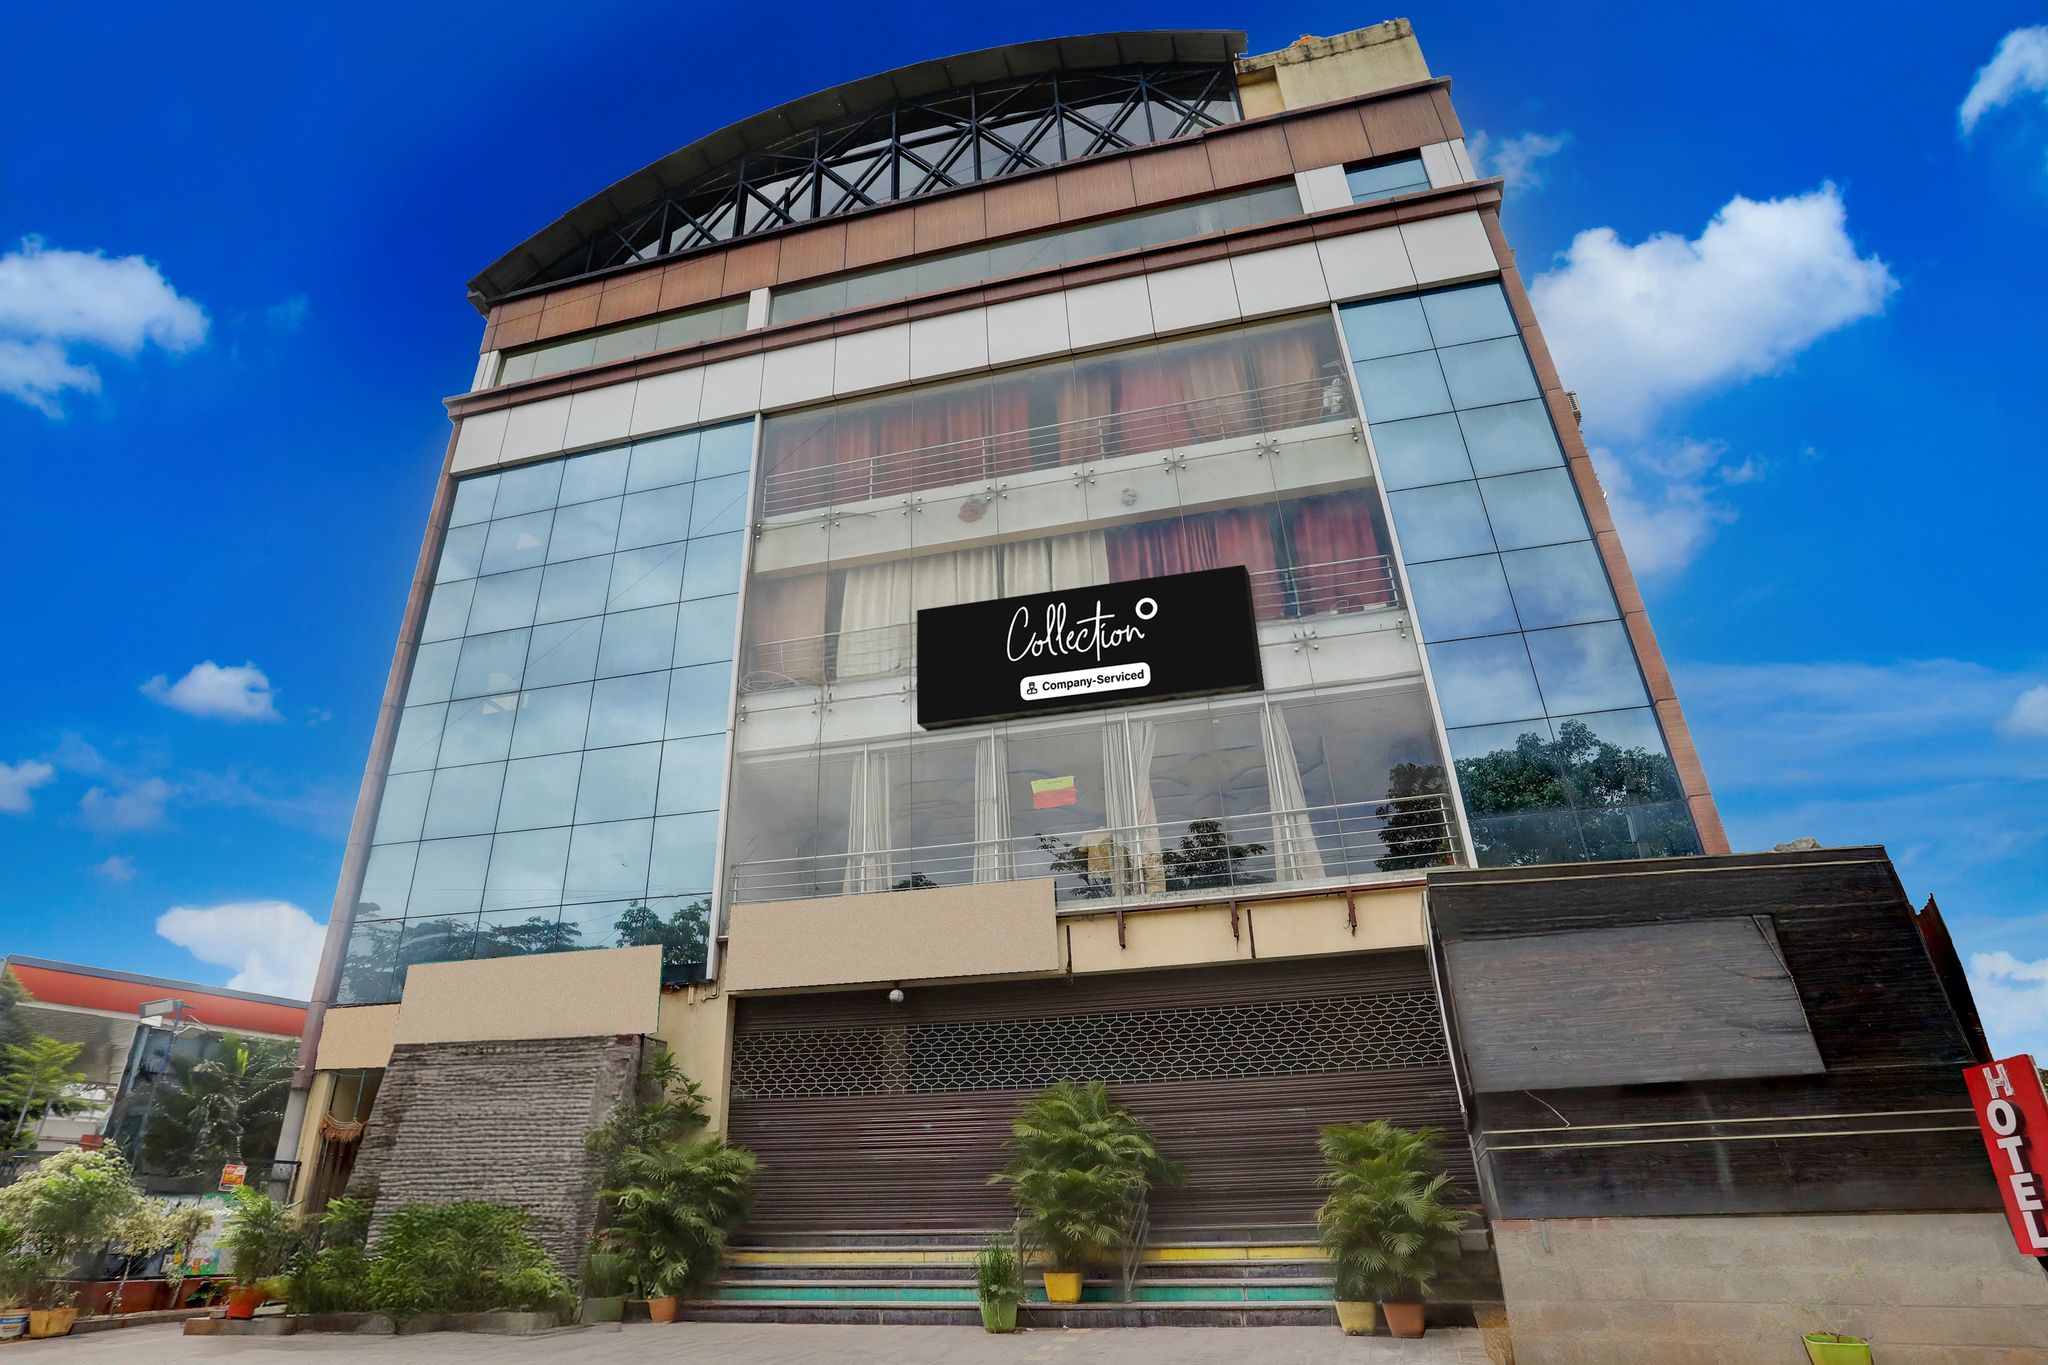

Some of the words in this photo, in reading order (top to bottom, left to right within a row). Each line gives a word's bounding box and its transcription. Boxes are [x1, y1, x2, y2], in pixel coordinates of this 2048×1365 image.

[1007, 600, 1146, 662] Collection
[1042, 669, 1145, 691] Company-Serviced
[1982, 1063, 2048, 1249] HOTEL
